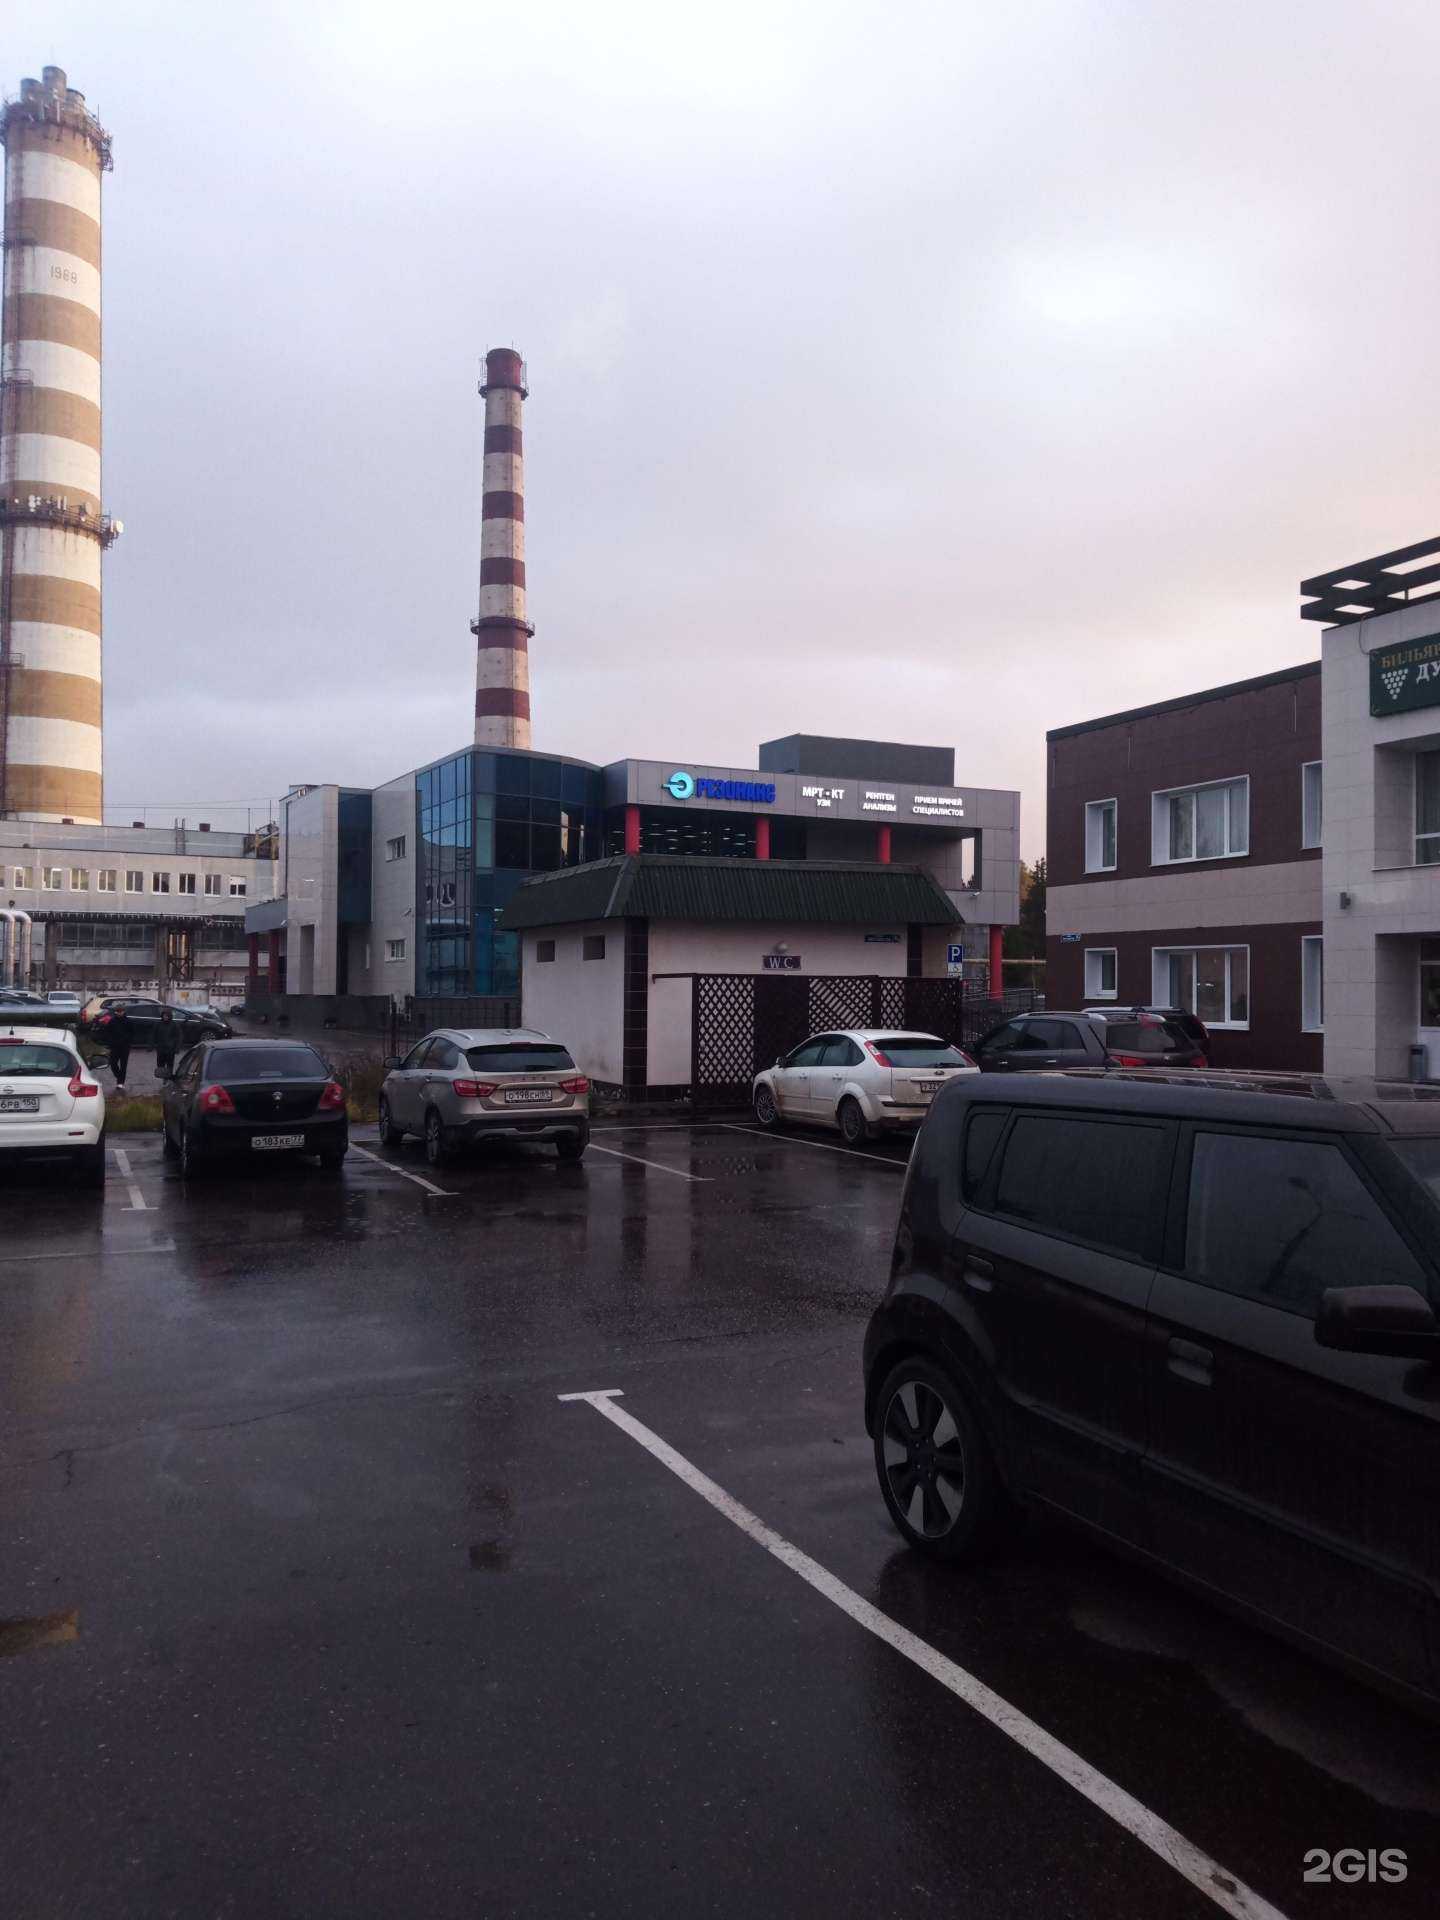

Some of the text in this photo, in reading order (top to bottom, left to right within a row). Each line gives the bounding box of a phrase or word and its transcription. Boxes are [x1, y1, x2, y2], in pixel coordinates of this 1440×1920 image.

[802, 786, 845, 800] МРТ КТ
[865, 791, 895, 801] РЕНТГЕН
[862, 802, 897, 812] АНАЛИЗЫ
[912, 806, 964, 816] СПЕЦИАЛИСТОВ
[951, 946, 961, 961] P
[769, 957, 794, 969] WC
